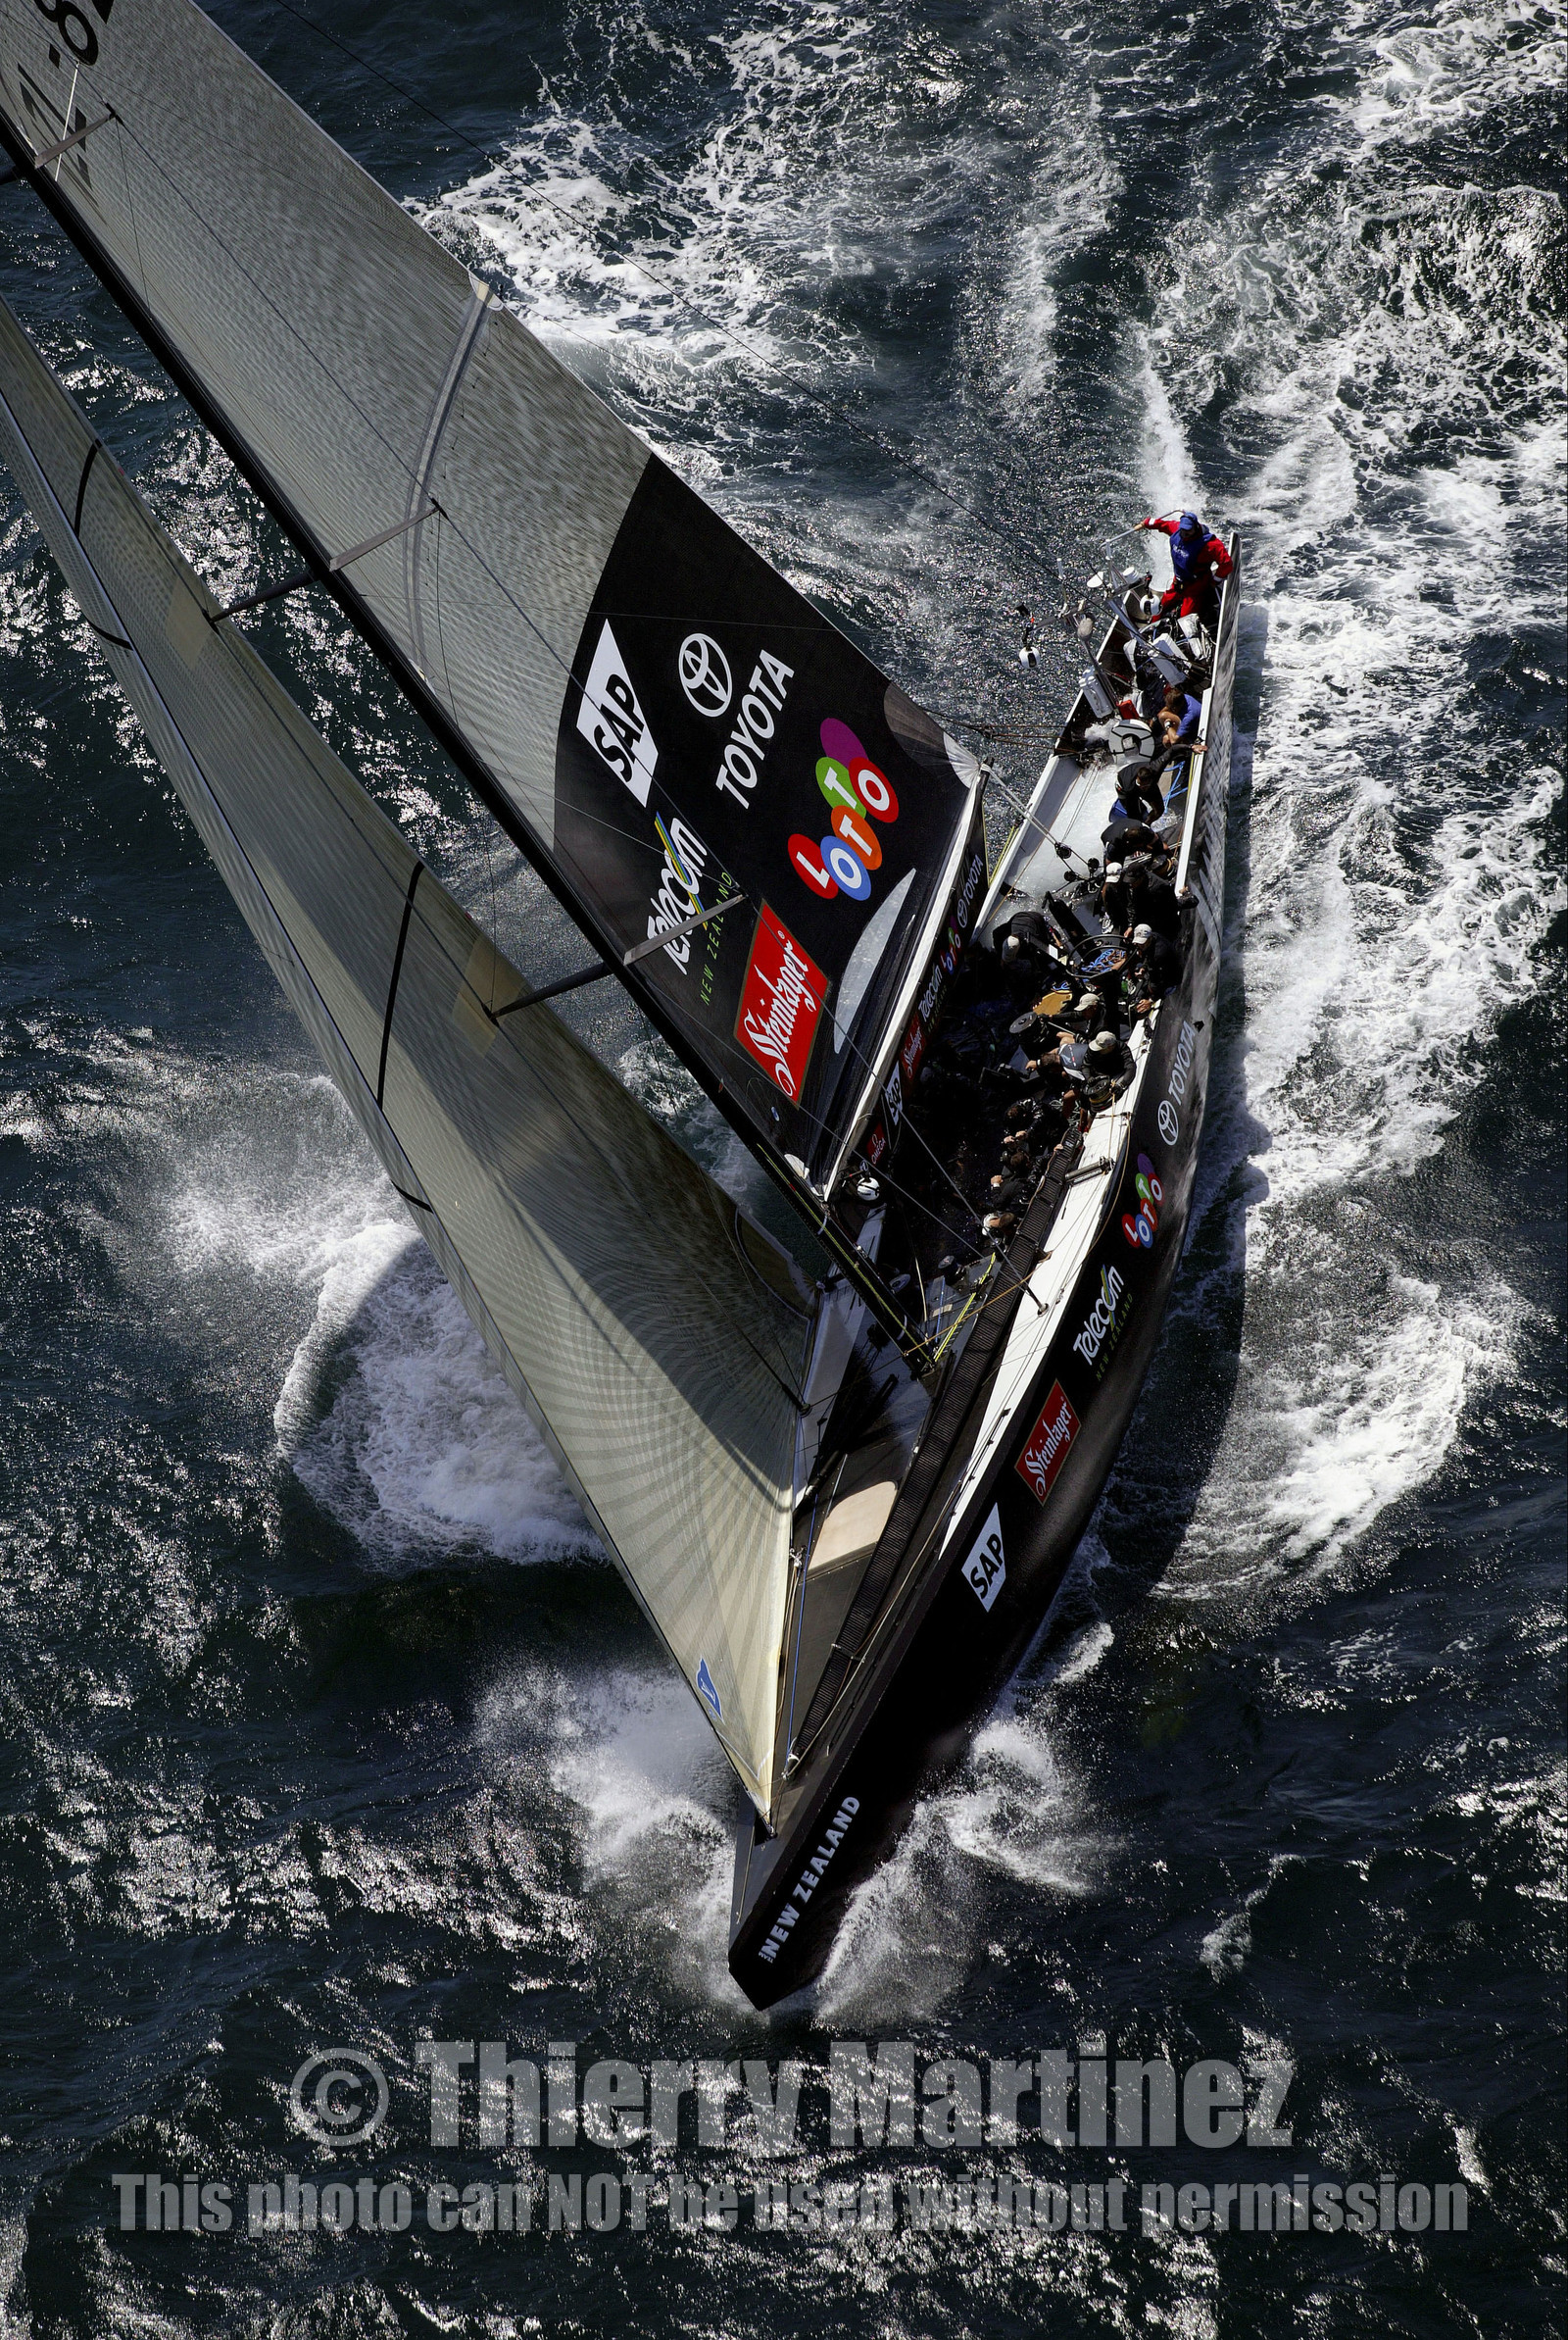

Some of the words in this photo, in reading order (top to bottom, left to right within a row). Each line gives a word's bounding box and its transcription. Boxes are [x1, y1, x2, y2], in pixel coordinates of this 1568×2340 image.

[594, 673, 644, 782] SAP
[715, 649, 794, 809] TOYOTA
[796, 767, 890, 889] LOTTO
[963, 855, 983, 906] TOYOTA
[700, 964, 714, 1006] NEW
[744, 940, 816, 1096] Steinlager
[1168, 1021, 1196, 1106] TOYOTA
[1124, 1178, 1162, 1242] LOTTO
[1073, 1266, 1124, 1366] Telecom
[1097, 1356, 1109, 1381] NEW
[1110, 1293, 1133, 1351] ZEALAND
[1025, 1402, 1073, 1497] Steinlager
[970, 1533, 1004, 1600] SAP
[762, 1903, 800, 1959] NEW
[793, 1796, 860, 1904] ZEALAND
